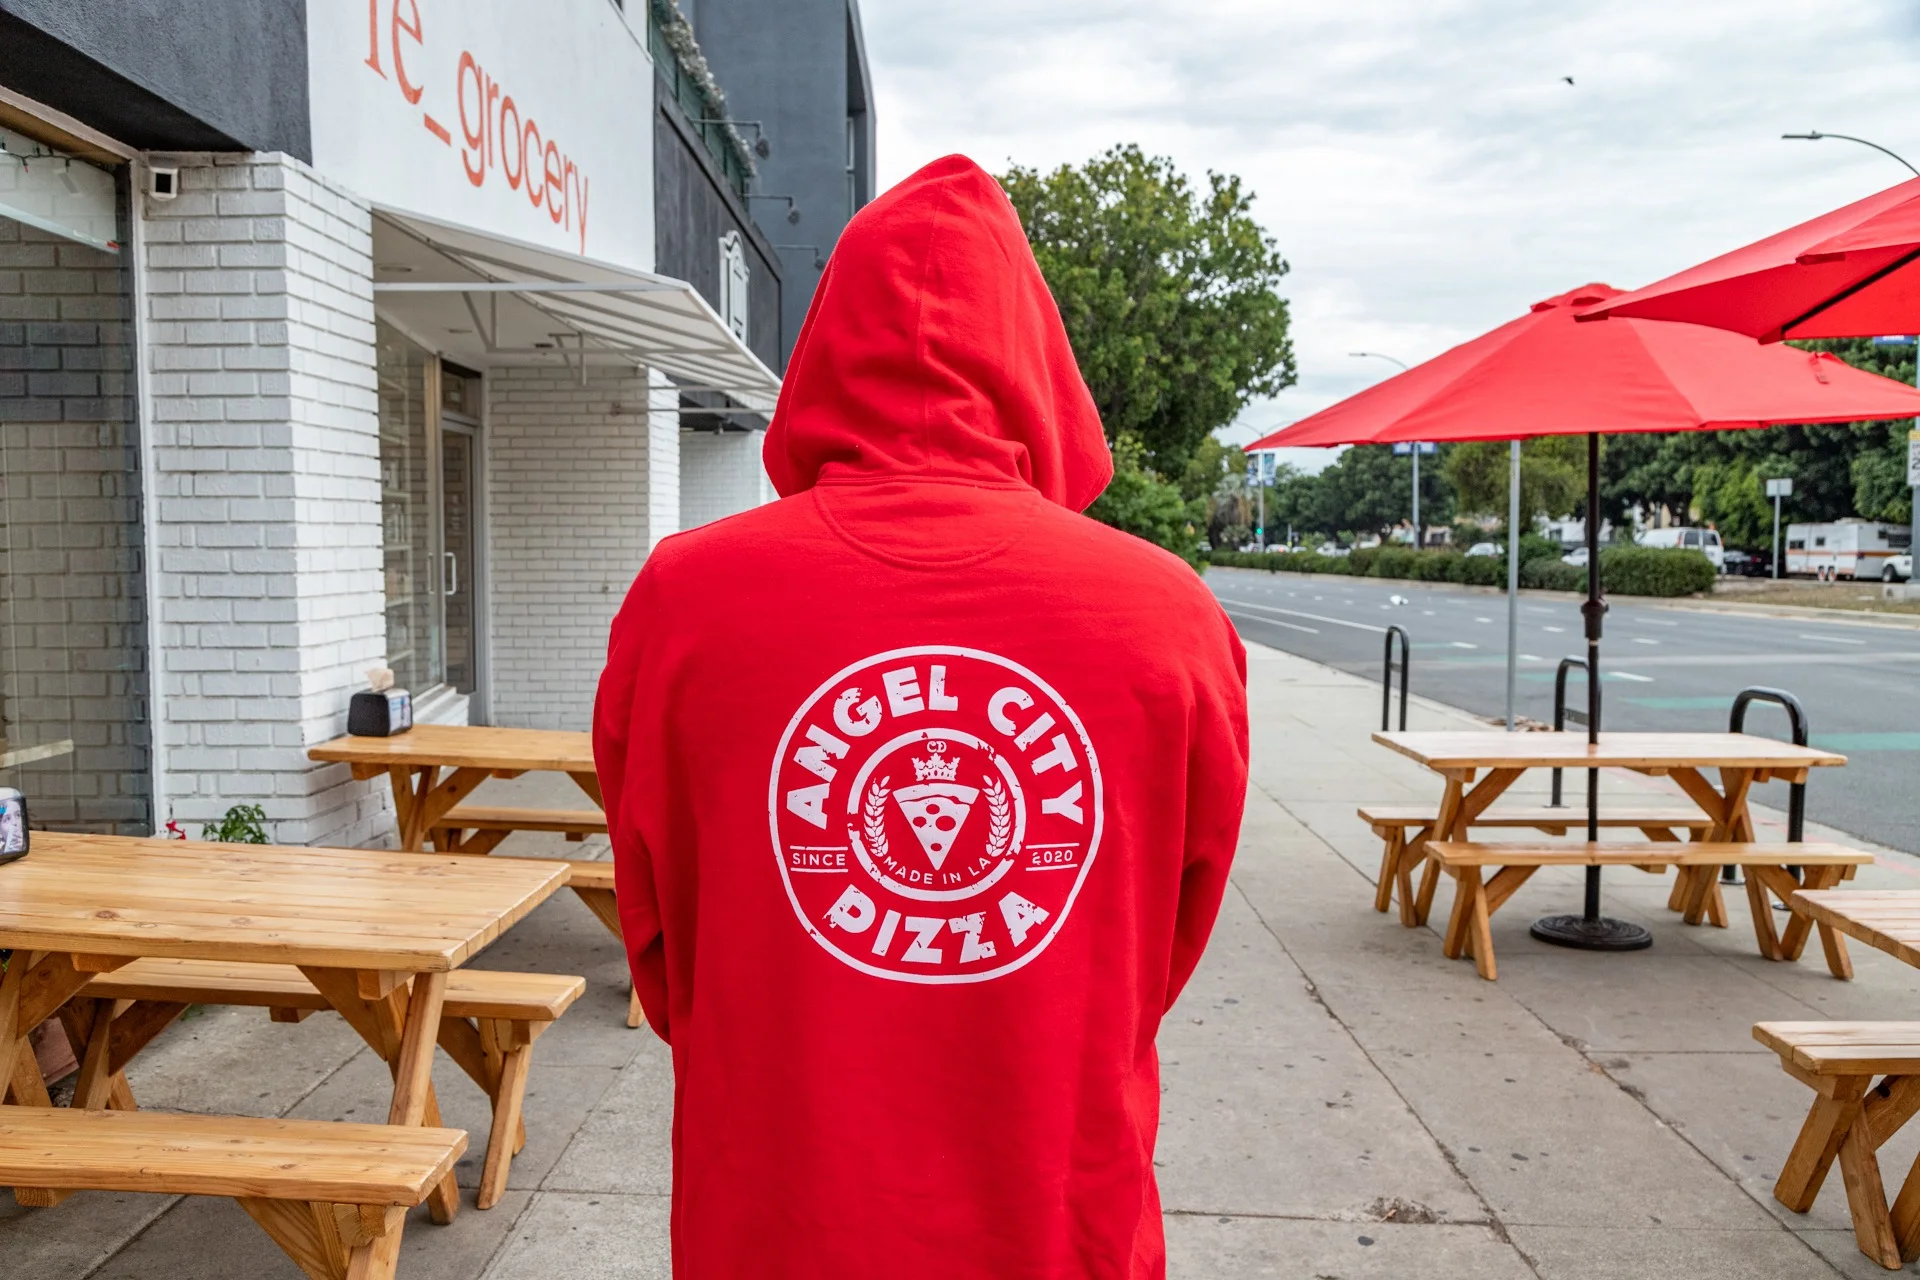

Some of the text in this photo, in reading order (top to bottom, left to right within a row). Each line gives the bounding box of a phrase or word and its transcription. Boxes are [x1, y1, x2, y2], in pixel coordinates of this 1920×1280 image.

[787, 665, 1084, 830] ANGEL CITY
[792, 852, 846, 866] SINCE
[883, 856, 991, 885] MADE IN LA
[1032, 850, 1073, 865] 2020
[822, 884, 1050, 964] PIZZA
